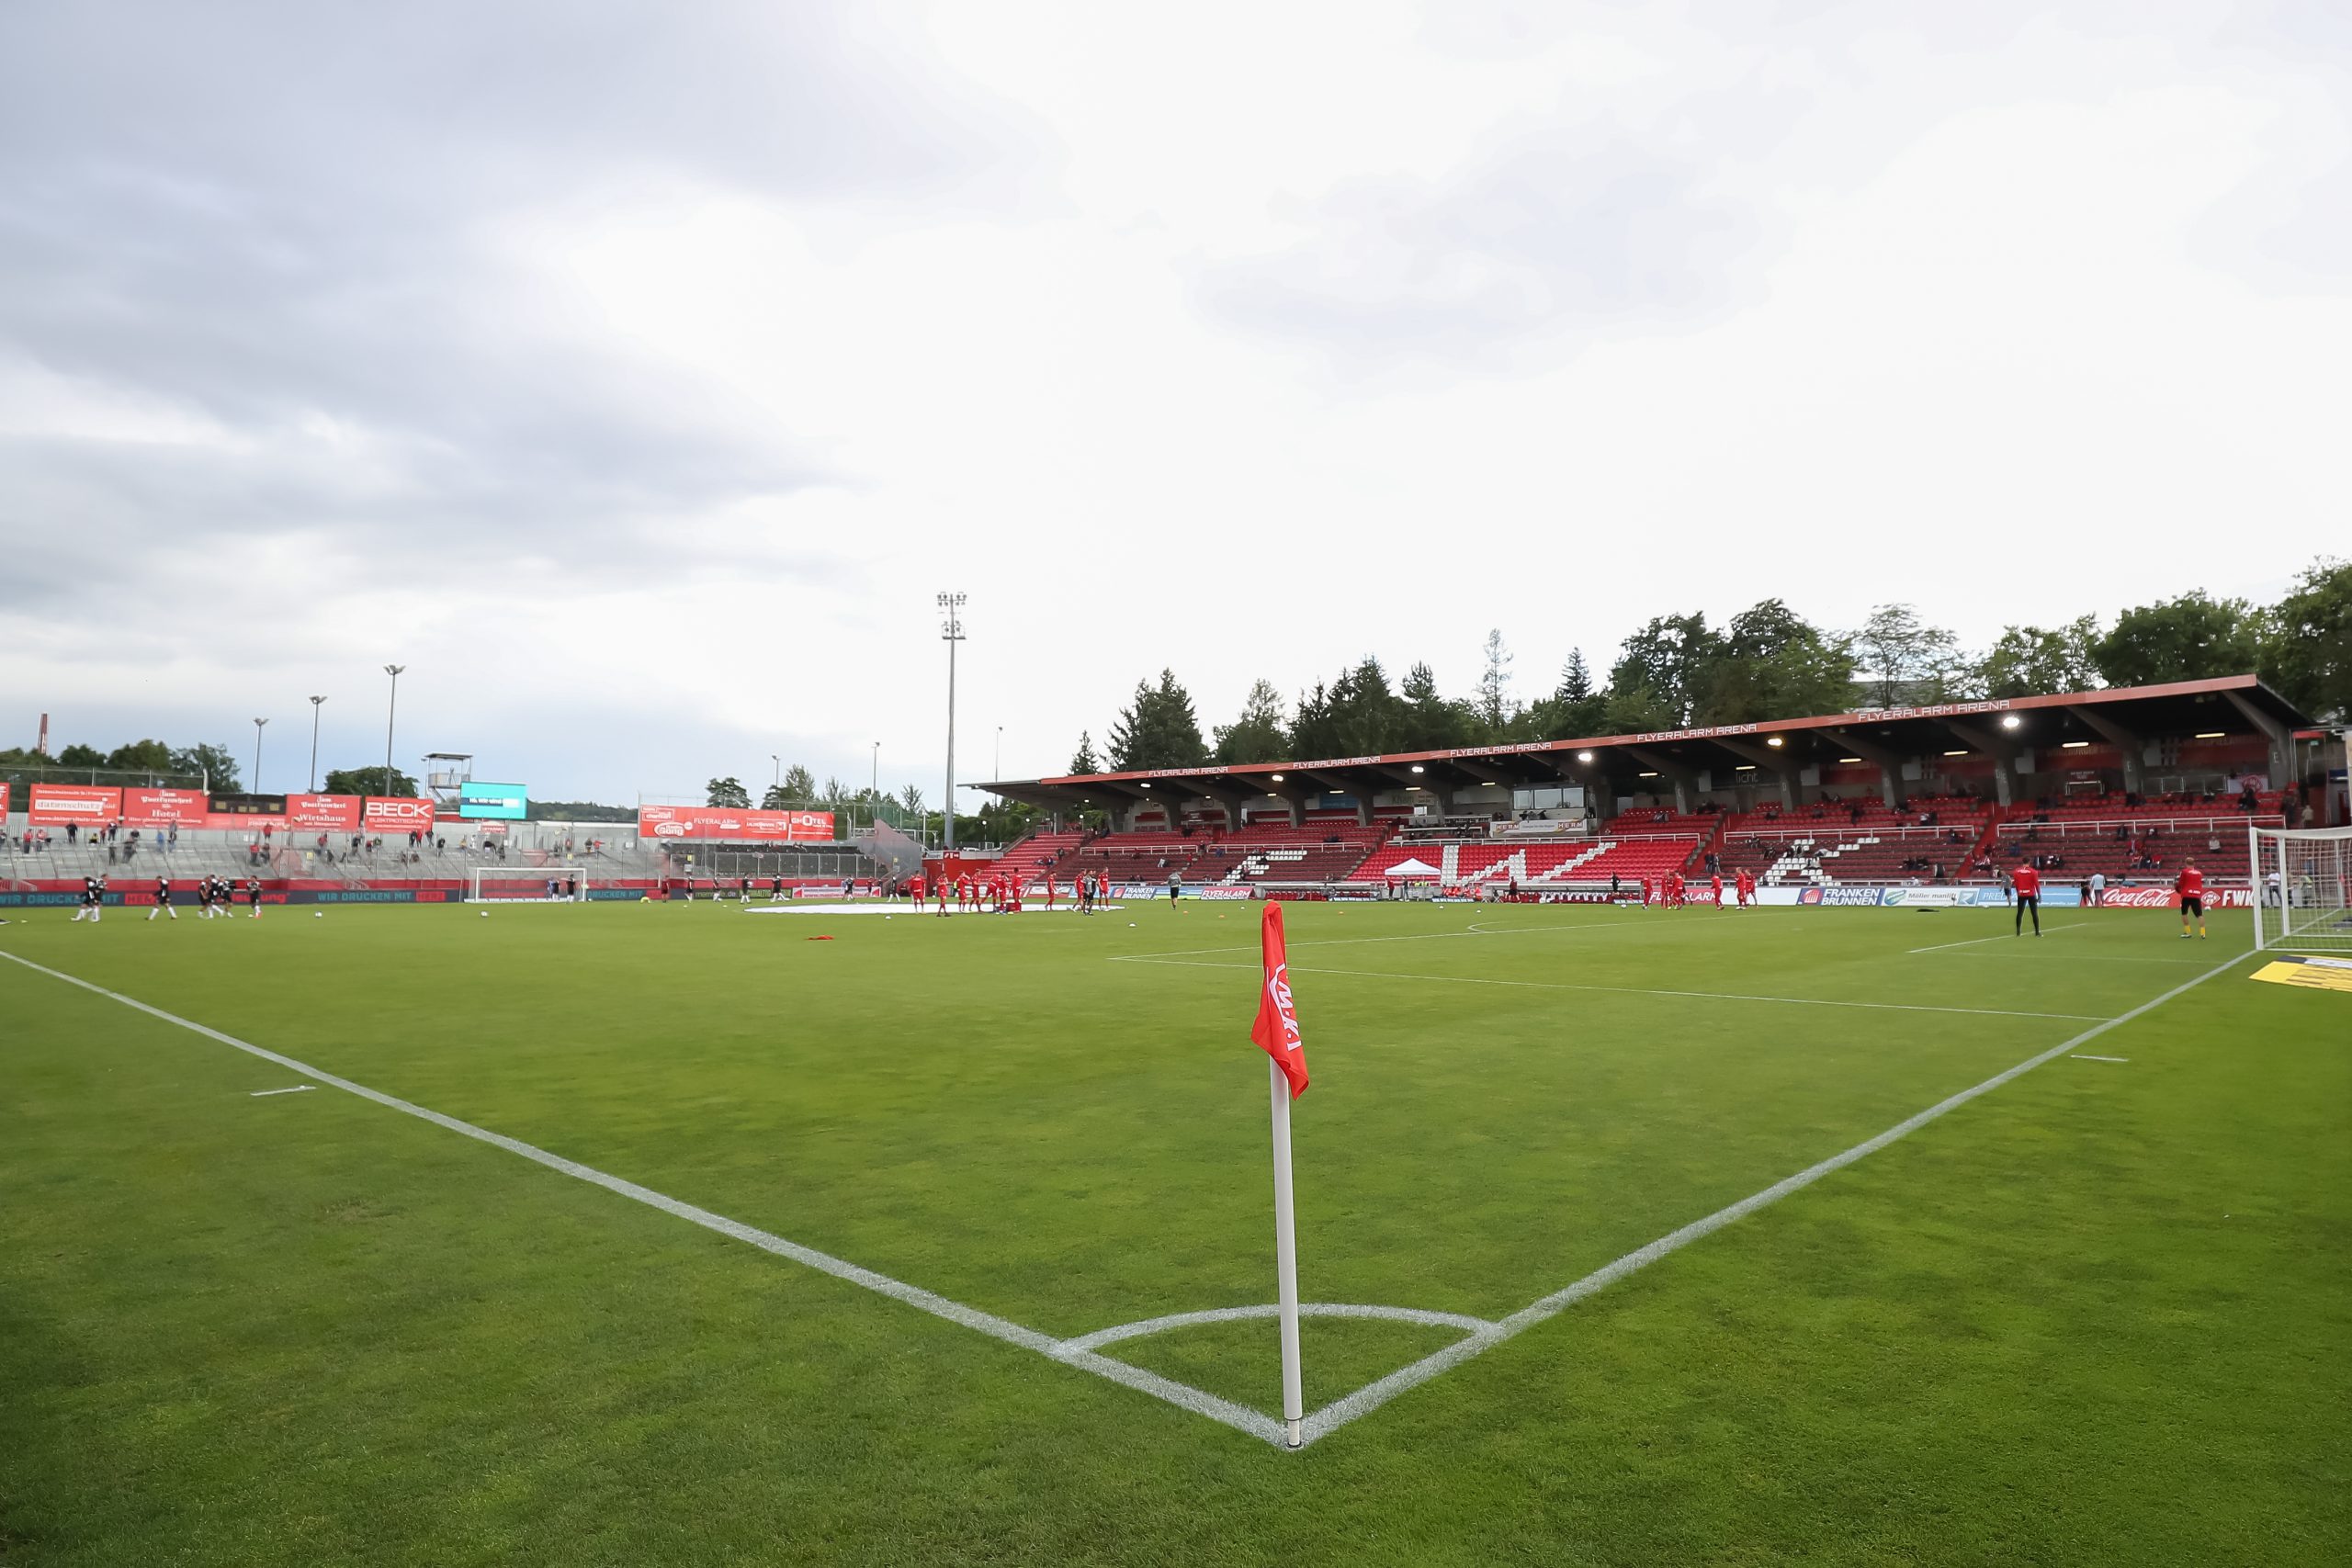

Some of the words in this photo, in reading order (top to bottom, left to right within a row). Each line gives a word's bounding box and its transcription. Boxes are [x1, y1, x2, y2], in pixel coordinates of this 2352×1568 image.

[1859, 705, 1953, 722] FLYERALARM
[1958, 700, 2010, 710] ARENA
[1637, 728, 1713, 742] FLYERALARM
[1716, 724, 1757, 735] ARENA
[1450, 745, 1514, 757] FLYERALARM
[1516, 742, 1552, 751] ARENA
[1293, 759, 1350, 769] FLYERALARM
[1351, 756, 1381, 764] ARENA
[1148, 768, 1200, 777] FLYERALARM
[1201, 766, 1228, 775] ARENA
[367, 801, 431, 818] BECK
[299, 814, 346, 822] Wirtshaus
[318, 892, 338, 901] WIR
[342, 892, 390, 901] DRUCKEN
[394, 892, 413, 901] MIT
[1201, 889, 1251, 897] FLYERALARM
[1824, 888, 1881, 897] FRANKEN
[2222, 889, 2255, 907] FWK
[1821, 897, 1878, 906] BRUNNEN
